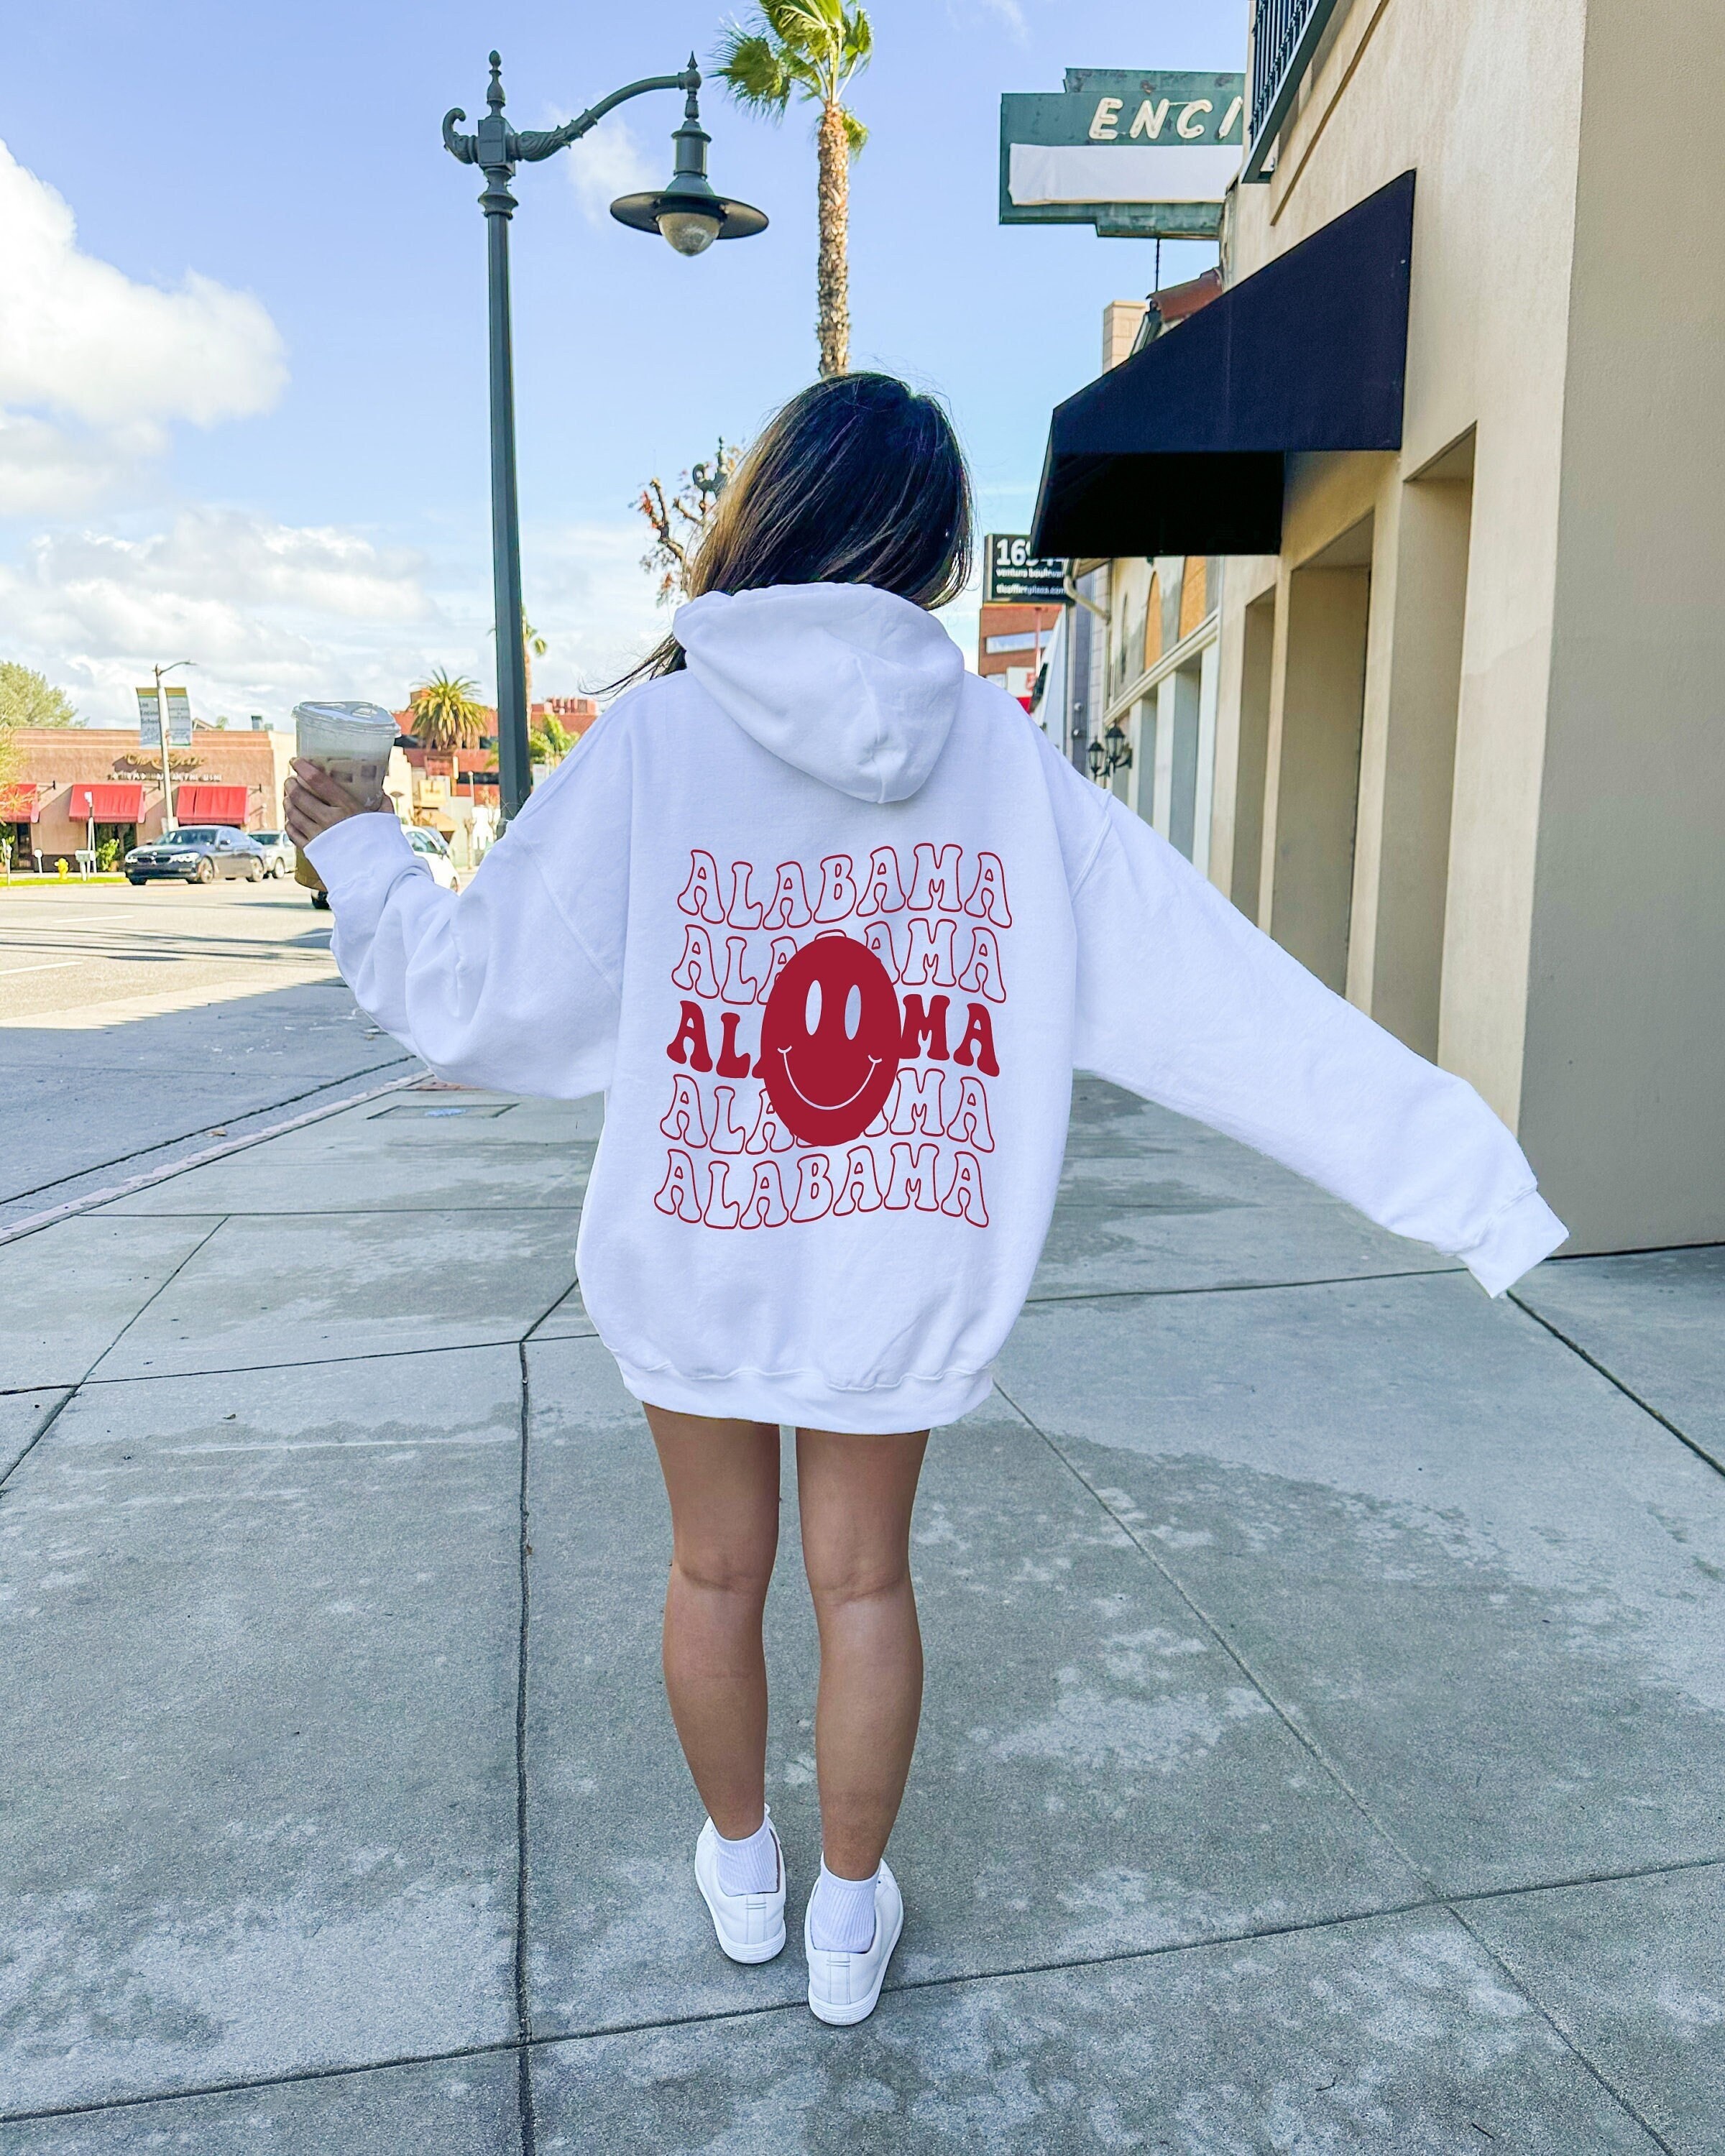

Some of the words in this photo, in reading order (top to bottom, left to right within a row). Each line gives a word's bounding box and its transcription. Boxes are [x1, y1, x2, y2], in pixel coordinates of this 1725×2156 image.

[1088, 96, 1243, 140] ENCI
[677, 843, 1013, 930] ALABAMA
[671, 918, 1007, 1005] ALAAMA
[667, 994, 1000, 1078] ALMA
[660, 1067, 995, 1154] ALAMA
[654, 1142, 989, 1230] ALABAMA
